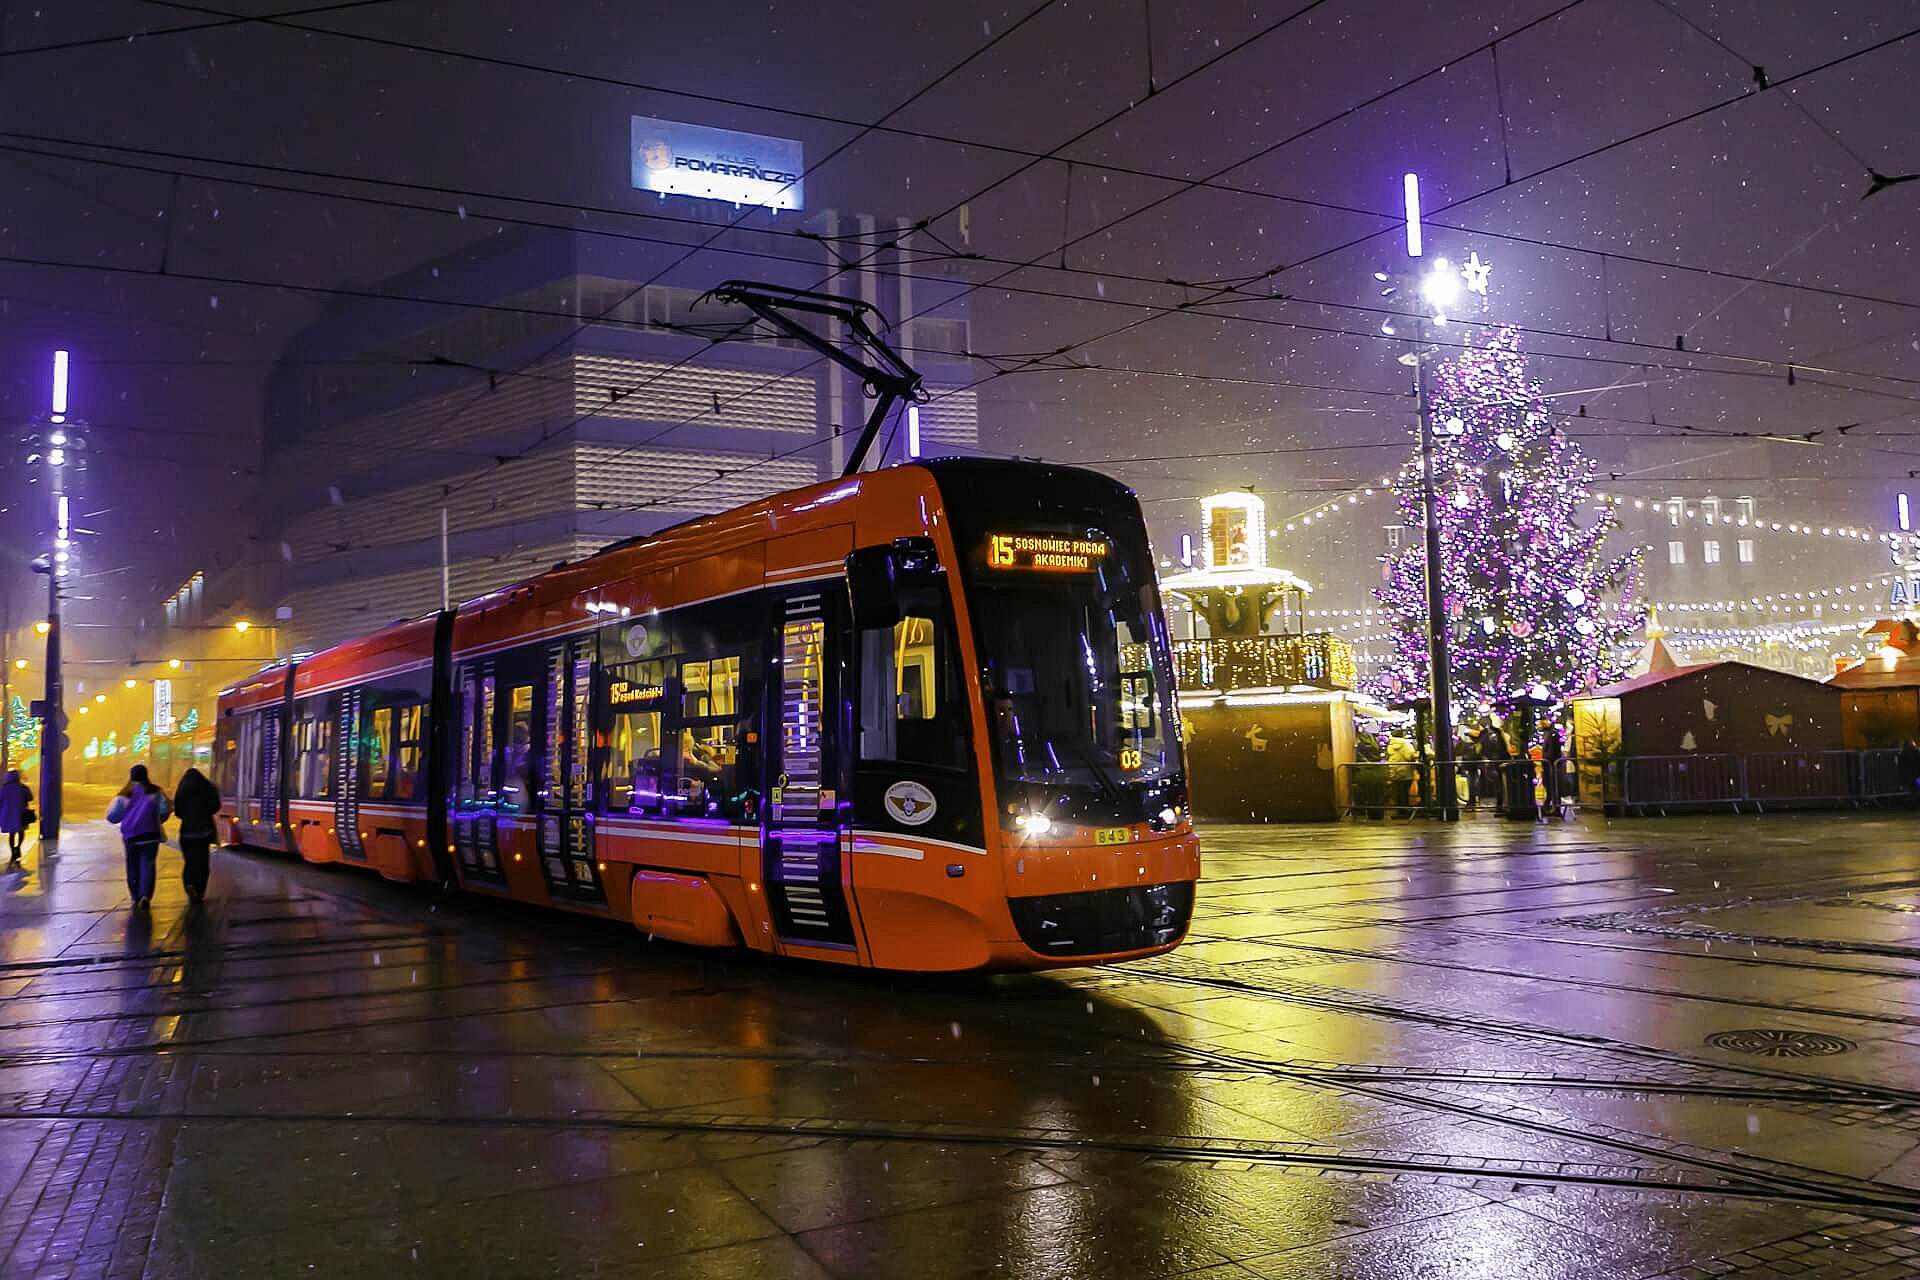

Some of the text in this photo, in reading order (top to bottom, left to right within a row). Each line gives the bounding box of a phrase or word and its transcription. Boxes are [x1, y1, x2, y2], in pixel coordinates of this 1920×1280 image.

[675, 157, 798, 184] POMARAŃCZA
[992, 535, 1014, 565] 15
[1015, 537, 1071, 553] SOSNOWIEC
[1035, 554, 1088, 568] AKADEMIKI
[1121, 750, 1141, 769] 03
[1098, 829, 1126, 843] 843
